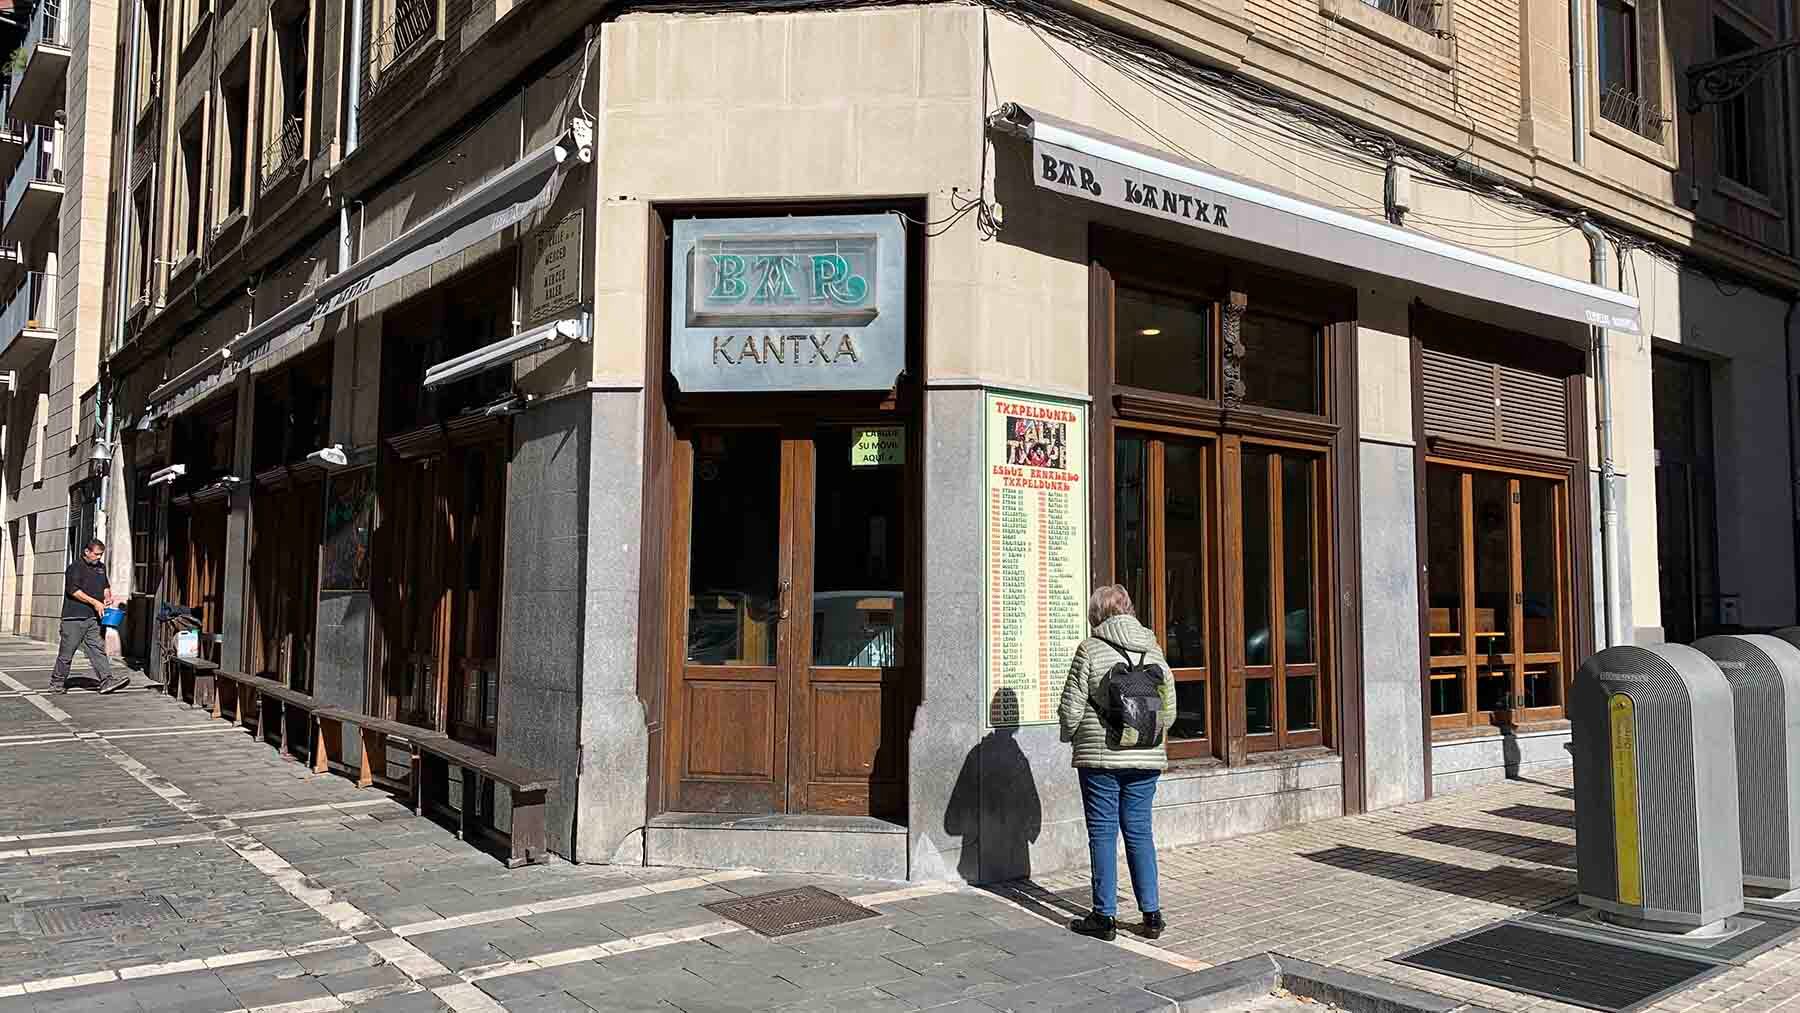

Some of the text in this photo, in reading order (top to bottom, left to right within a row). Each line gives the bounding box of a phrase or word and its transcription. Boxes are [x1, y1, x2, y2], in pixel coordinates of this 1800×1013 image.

[1041, 153, 1228, 228] BAR KANTXA
[707, 252, 868, 305] BAR
[712, 333, 858, 365] KANTXA
[995, 401, 1077, 423] TXAPELDUNAK
[858, 442, 870, 450] SU
